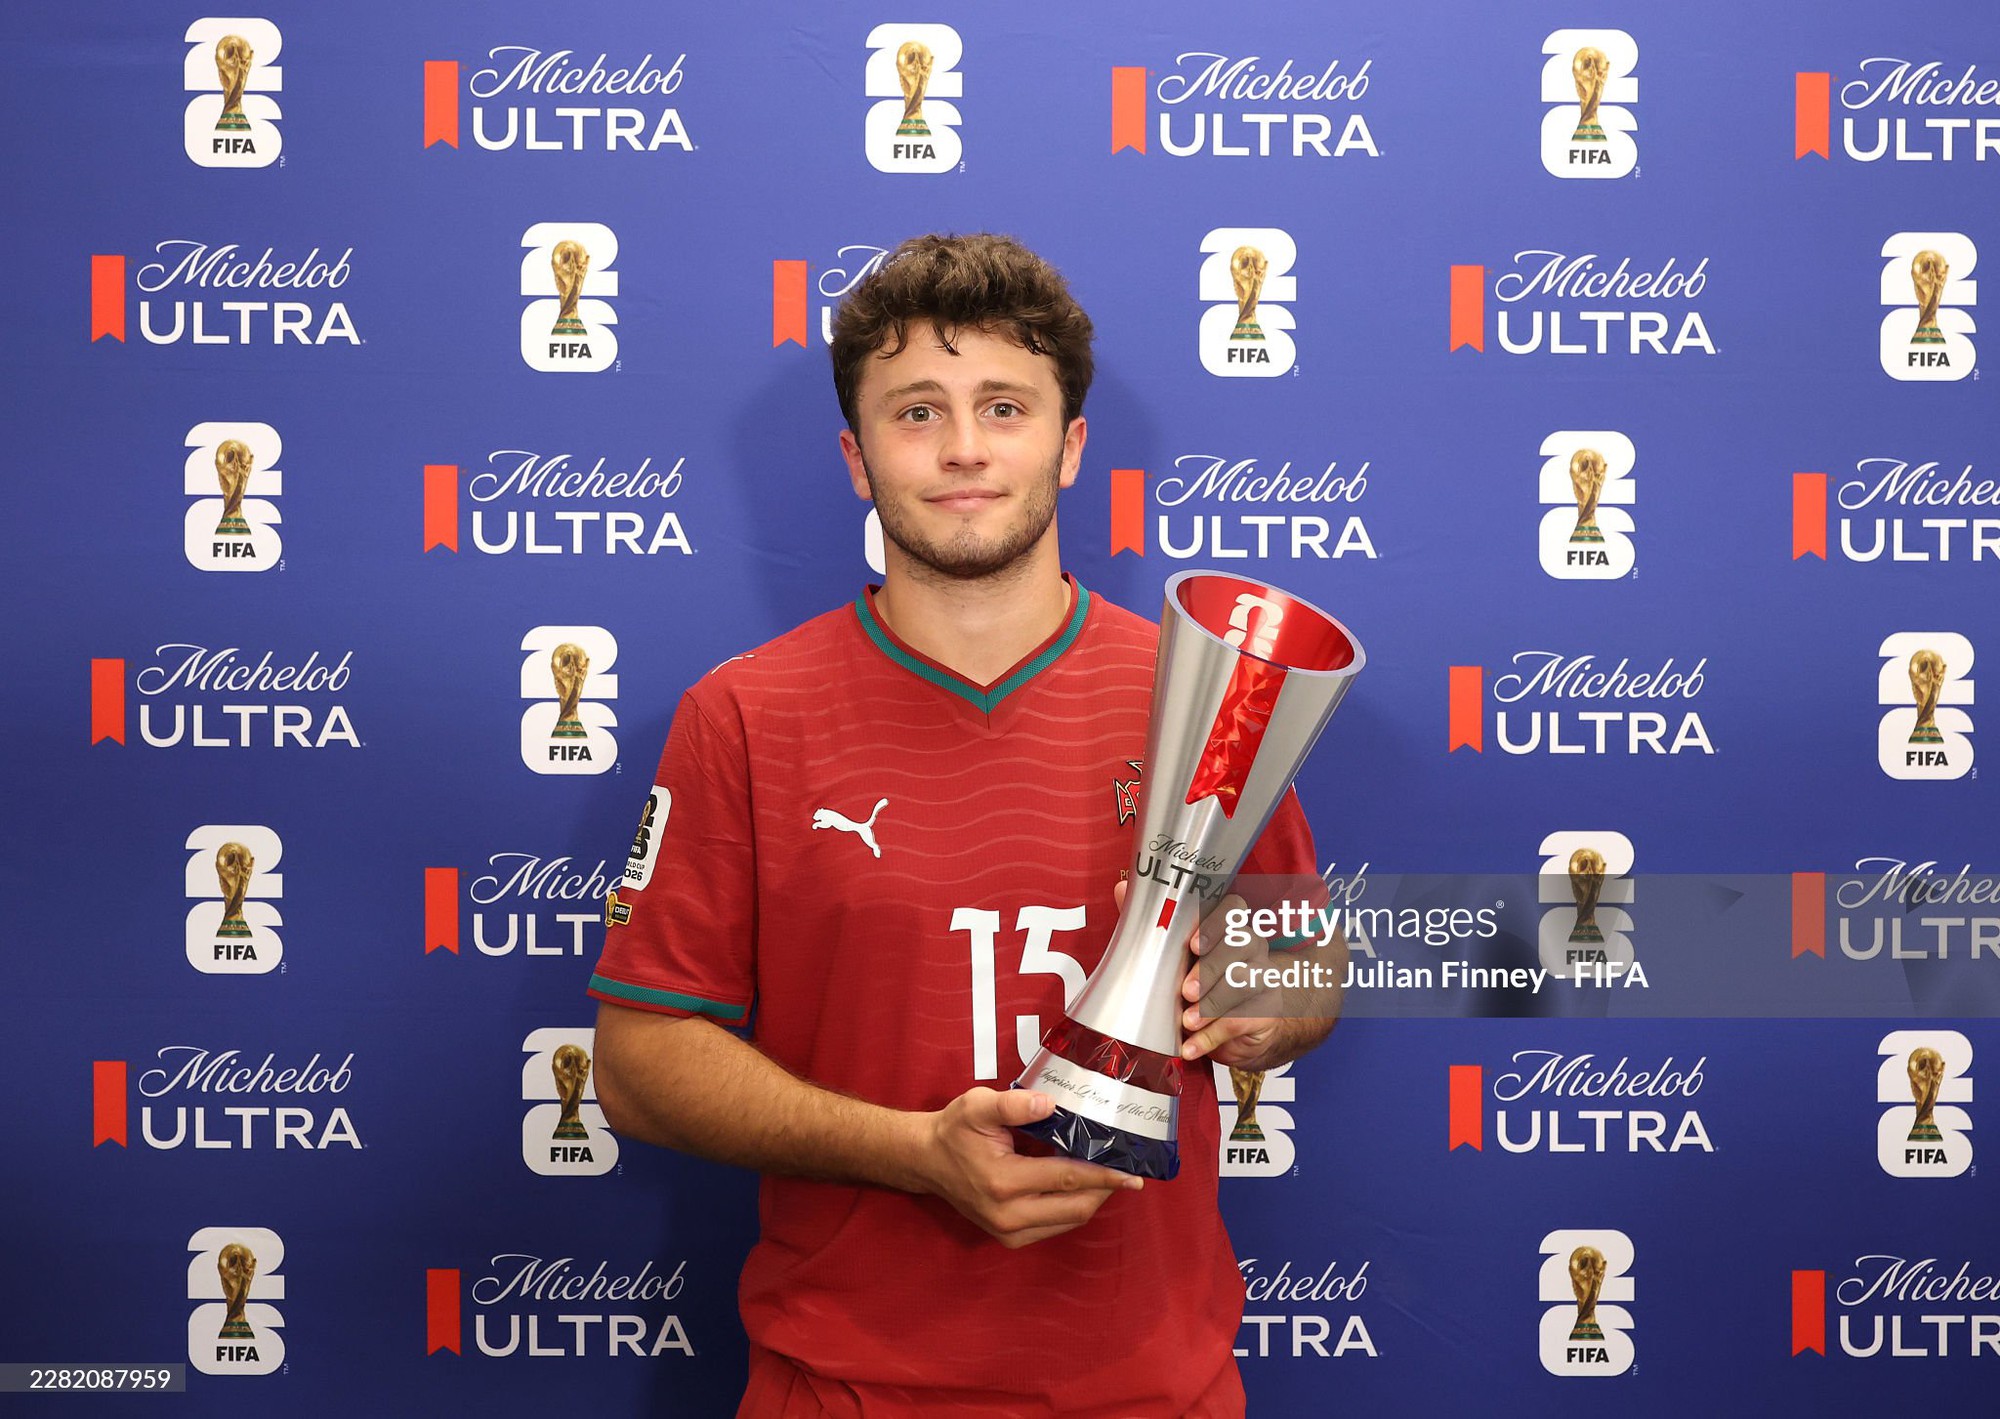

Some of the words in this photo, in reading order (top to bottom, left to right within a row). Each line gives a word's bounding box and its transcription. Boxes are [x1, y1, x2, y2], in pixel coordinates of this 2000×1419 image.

[470, 46, 687, 97] Michelob
[1156, 52, 1373, 104] Michelob
[1840, 57, 2000, 110] Miche
[213, 139, 255, 154] FIFA
[473, 107, 693, 151] ULTRA
[1160, 113, 1380, 157] ULTRA
[1843, 118, 2000, 162] ULTR
[893, 144, 936, 159] FIFA
[1569, 149, 1612, 164] FIFA
[137, 240, 353, 292] Michelob
[1495, 250, 1710, 302] Michelob
[140, 302, 360, 345] ULTRA
[1498, 311, 1717, 354] ULTRA
[549, 343, 592, 358] FIFA
[1227, 348, 1270, 363] FIFA
[1908, 352, 1951, 367] FIFA
[470, 450, 685, 501] Michelob
[1156, 455, 1371, 506] Michelob
[1837, 457, 2000, 510] Miche
[213, 542, 256, 557] FIFA
[473, 511, 693, 555] ULTRA
[1159, 515, 1378, 559] ULTRA
[1840, 518, 2000, 562] ULTR
[1567, 550, 1609, 565] FIFA
[137, 644, 353, 695] Michelob
[1494, 651, 1708, 702] Michelob
[140, 705, 360, 747] ULTRA
[1497, 712, 1715, 754] ULTRA
[549, 746, 592, 761] FIFA
[1906, 751, 1948, 766] FIFA
[1148, 833, 1227, 872] Michelob
[470, 853, 623, 904] Miche
[624, 868, 643, 881] 026
[1136, 851, 1226, 903] ULTRA
[1836, 857, 2000, 909] Miche
[214, 945, 257, 960] FIFA
[474, 914, 601, 956] ULT
[1839, 917, 2000, 961] ULTR
[949, 905, 1089, 1080] 15
[138, 1046, 355, 1097] Michelob
[1493, 1050, 1707, 1101] Michelob
[142, 1107, 362, 1149] ULTRA
[1496, 1111, 1714, 1153] ULTRA
[550, 1147, 594, 1162] FIFA
[1227, 1148, 1270, 1164] FIFA
[1905, 1149, 1948, 1164] FIFA
[472, 1254, 686, 1305] Michelob
[1238, 1258, 1370, 1302] chelob
[1836, 1255, 2000, 1306] Miche
[216, 1346, 260, 1361] FIFA
[475, 1315, 694, 1357] ULTRA
[1232, 1315, 1379, 1357] TRA
[1567, 1347, 1609, 1363] FIFA
[1839, 1315, 2000, 1358] ULTR
